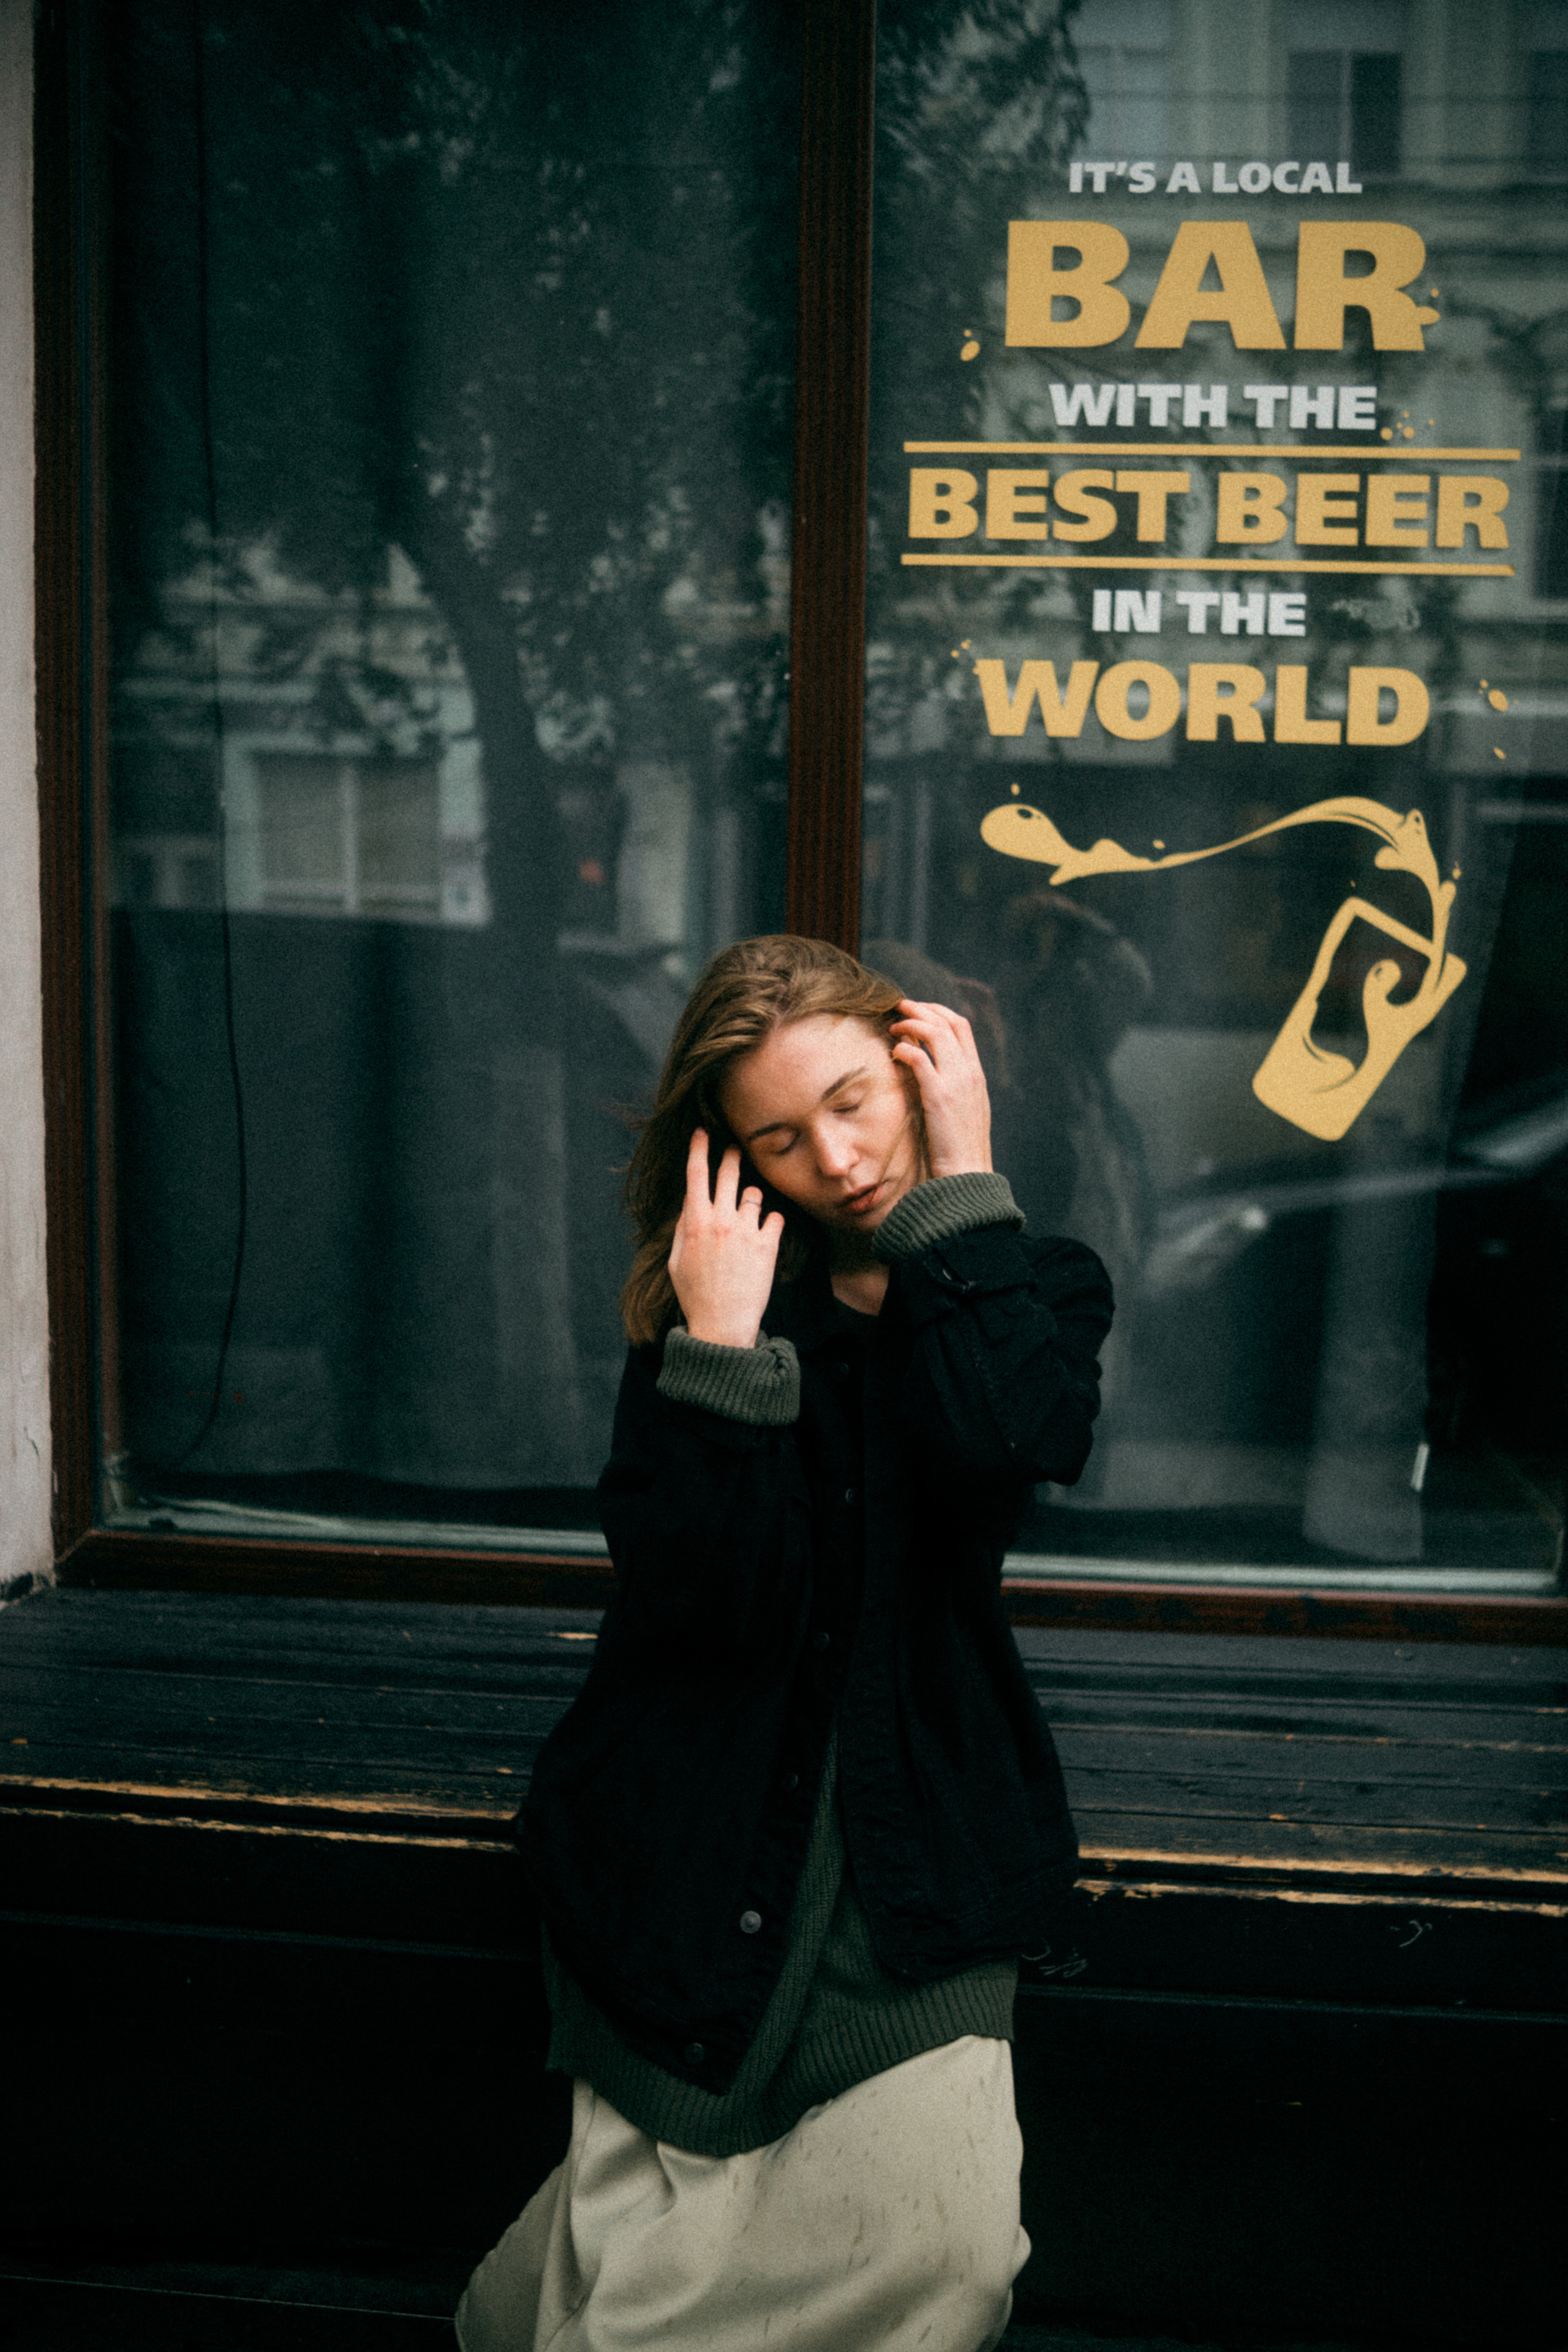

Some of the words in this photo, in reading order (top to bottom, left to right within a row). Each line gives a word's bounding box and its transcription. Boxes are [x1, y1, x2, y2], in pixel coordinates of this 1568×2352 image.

[1069, 162, 1156, 192] IT'S
[1167, 162, 1200, 192] A
[1213, 162, 1362, 193] LOCAL
[1005, 221, 1427, 350] BAR
[1049, 383, 1228, 427] WITH
[1243, 385, 1377, 429] THE
[908, 468, 1192, 541] BEST
[1216, 472, 1509, 549] BEER
[1093, 589, 1161, 632] IN
[1175, 590, 1306, 636] THE
[976, 658, 1430, 745] WORLD
